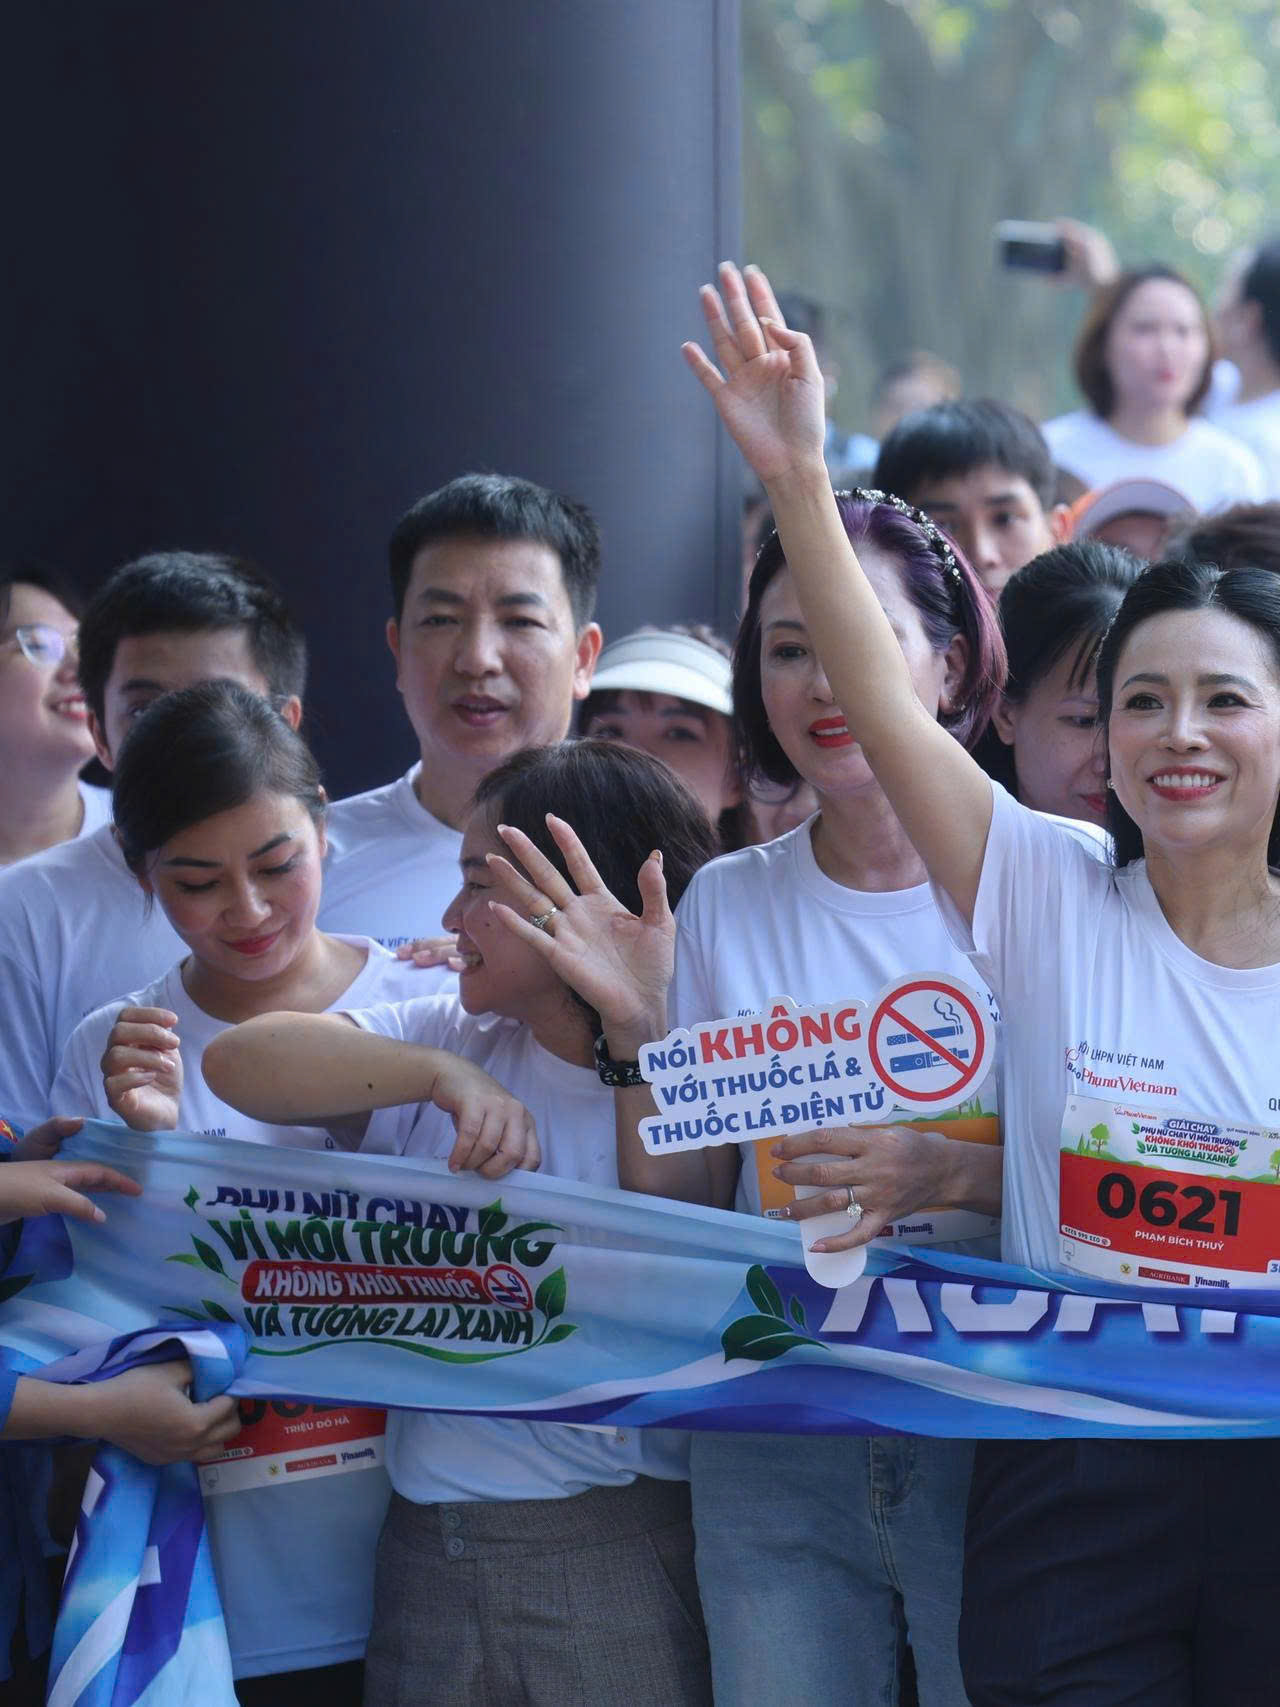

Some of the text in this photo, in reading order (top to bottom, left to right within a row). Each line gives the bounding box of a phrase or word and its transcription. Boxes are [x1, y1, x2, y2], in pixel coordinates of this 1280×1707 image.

[648, 1038, 697, 1072] NÓI
[699, 1004, 862, 1064] KHÔNG
[1090, 1049, 1115, 1064] LHPN
[1117, 1053, 1138, 1067] VIỆT
[1140, 1057, 1165, 1071] NAM
[661, 1050, 863, 1106] VỚI THUỐC LÁ &
[648, 1082, 885, 1145] THUỐC LÁ ĐIỆN TỬ
[1097, 1172, 1242, 1236] 0621
[206, 1209, 270, 1261] VÌ
[265, 1215, 353, 1263] MÔI
[1135, 1230, 1166, 1243] PHẠM
[1168, 1233, 1194, 1247] BÍCH
[255, 1266, 343, 1297] KHÔNG
[400, 1270, 482, 1300] THUỐC
[1195, 1275, 1230, 1289] Vinamilk
[243, 1301, 286, 1337] VÀ
[392, 1307, 451, 1338] LAI
[444, 1302, 534, 1345] XANH
